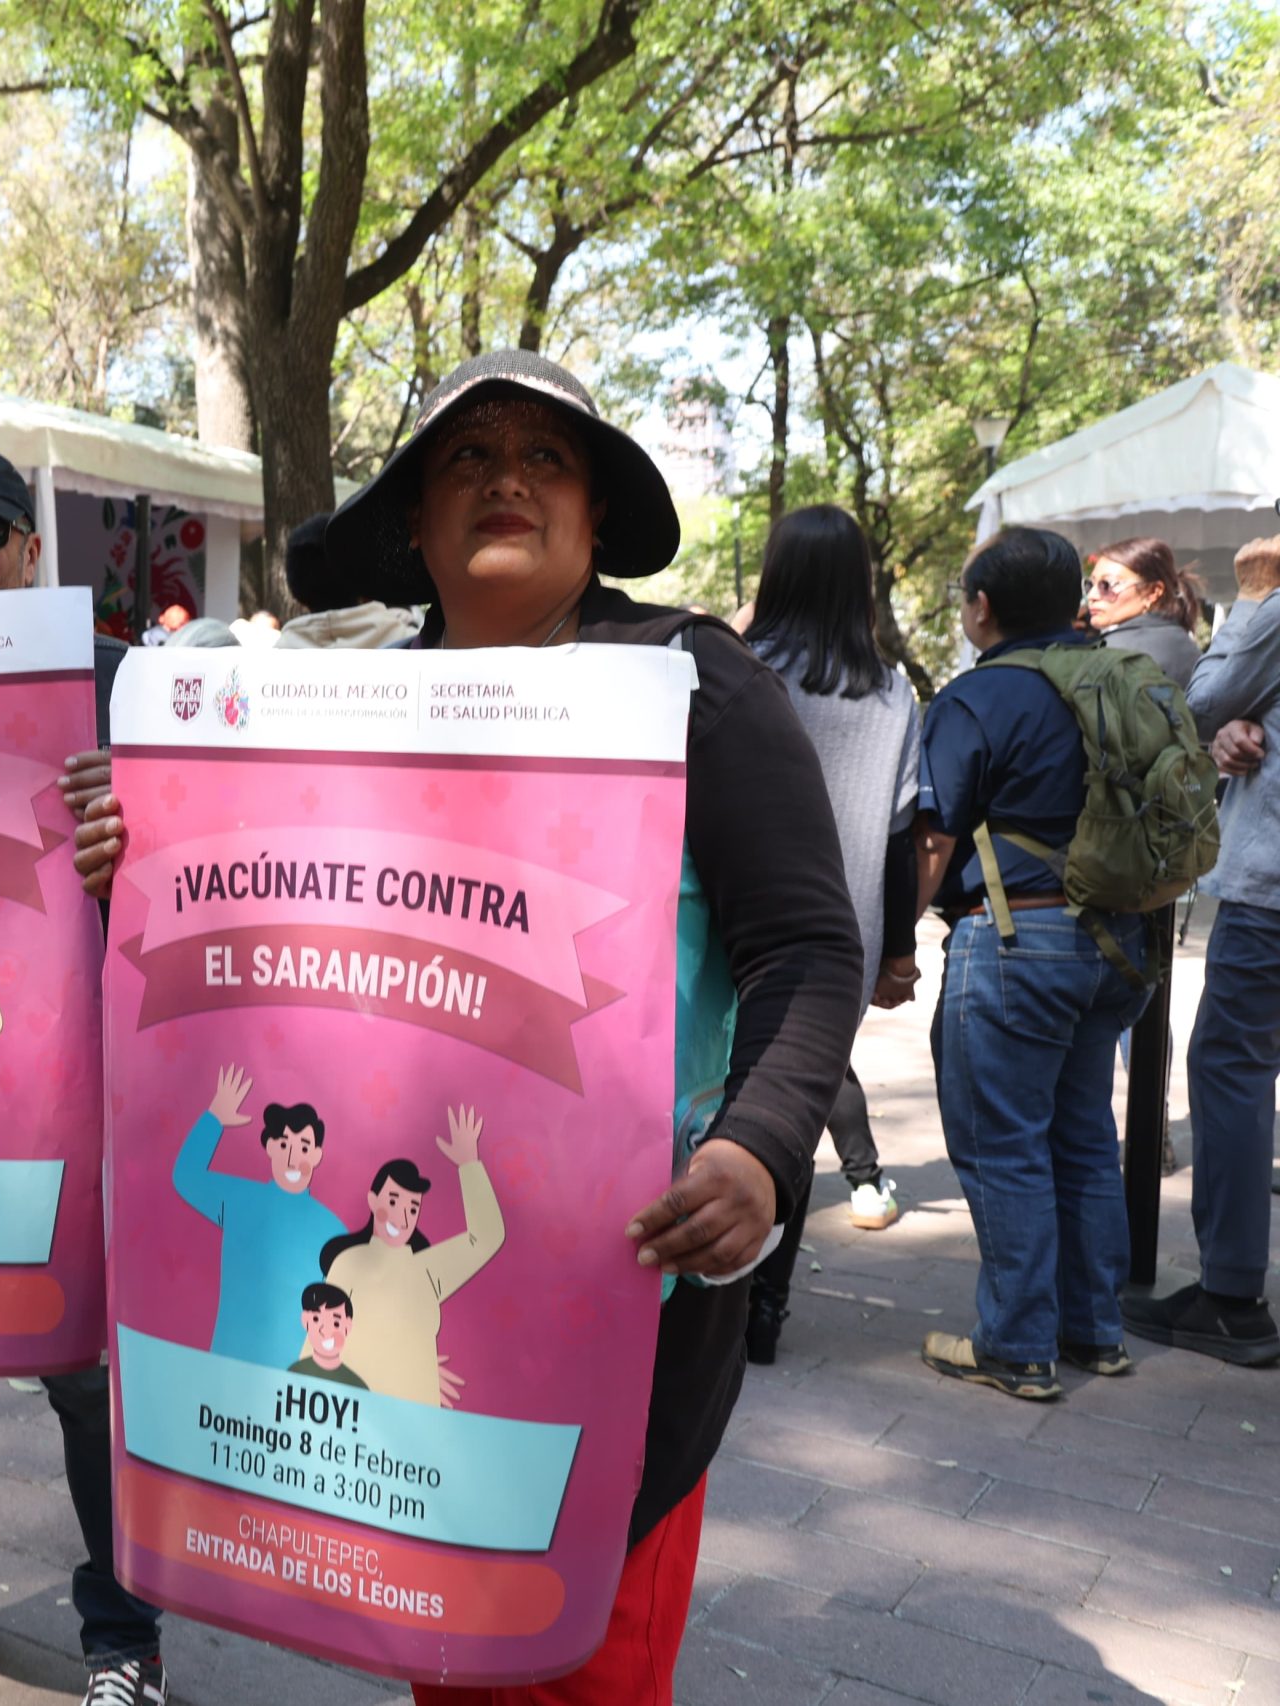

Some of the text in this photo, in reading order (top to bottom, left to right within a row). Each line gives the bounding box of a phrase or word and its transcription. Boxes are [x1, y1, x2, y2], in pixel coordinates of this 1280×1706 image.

[261, 683, 318, 699] CIUDAD
[322, 684, 341, 699] DE
[430, 680, 515, 698] SECRETARÍA
[430, 702, 570, 721] DE SALUD PÚBLICA
[175, 852, 530, 934] ¡VACÚNATE CONTRA
[205, 945, 487, 1019] EL SARAMPIÓN!
[275, 1384, 360, 1433] ¡HOY!
[199, 1404, 441, 1488] Domingo 8 de Febrero
[210, 1442, 425, 1520] 11:00 am a 3:00 pm
[186, 1528, 444, 1618] ENTRADA DE LOS LEONES
[239, 1514, 383, 1580] CHAPULTEPEC,
